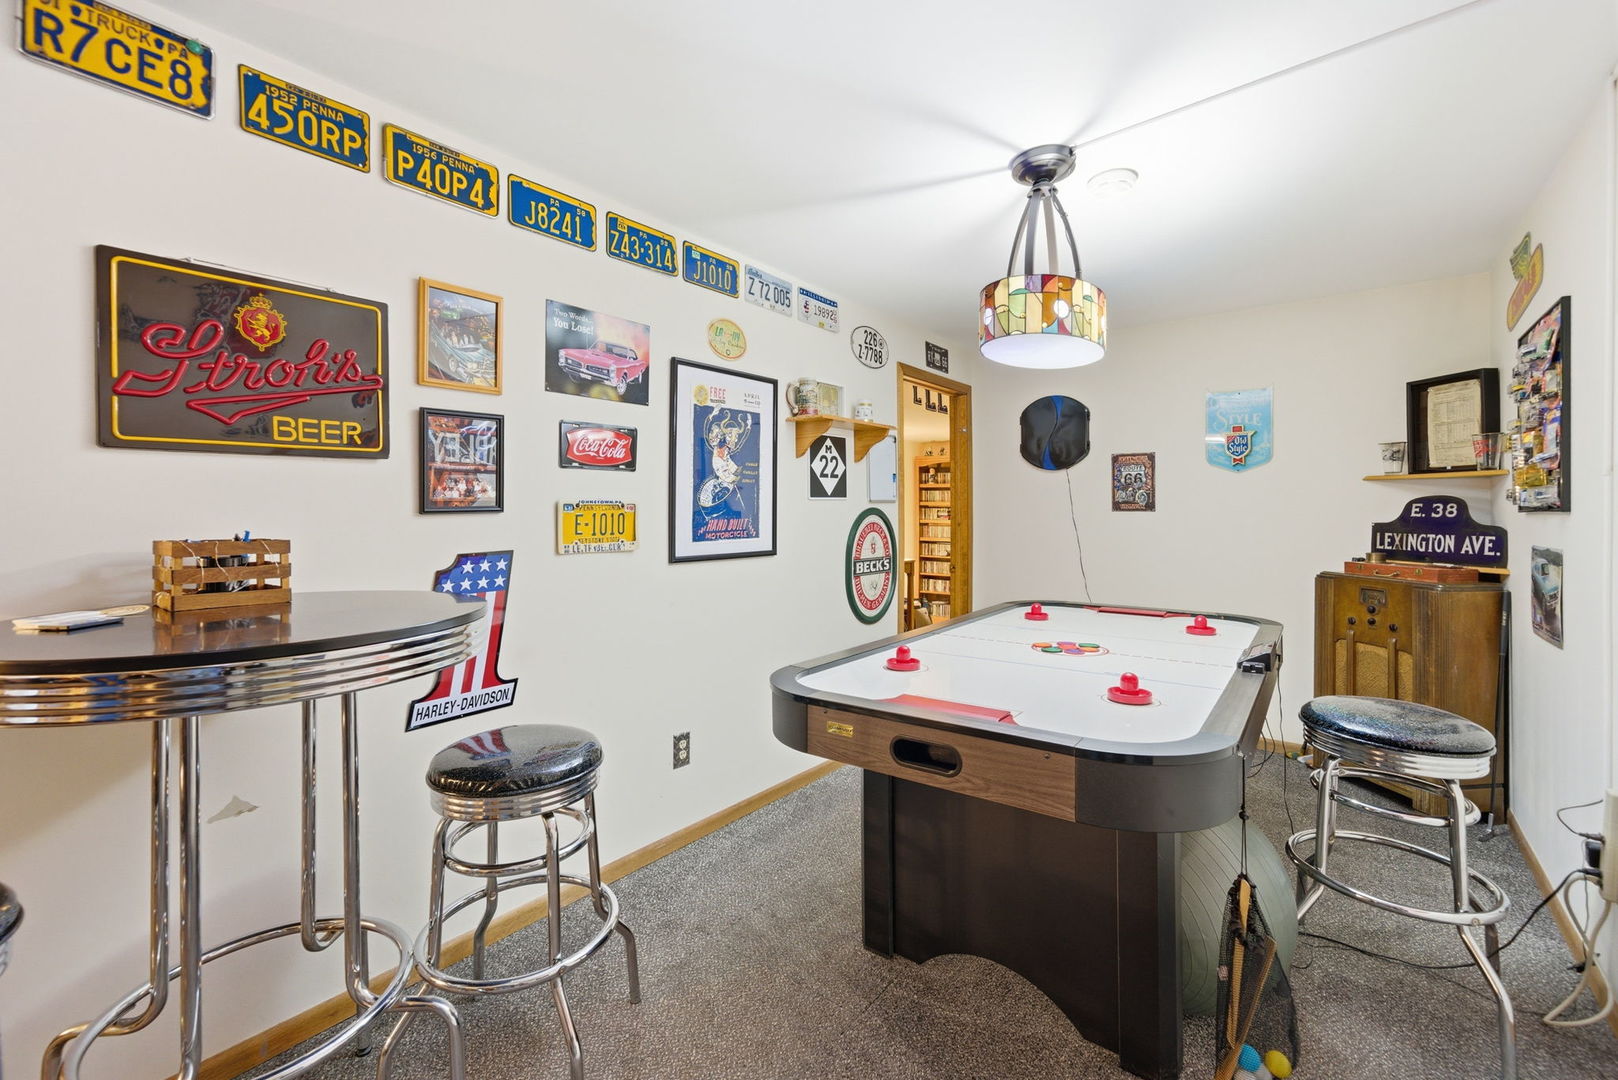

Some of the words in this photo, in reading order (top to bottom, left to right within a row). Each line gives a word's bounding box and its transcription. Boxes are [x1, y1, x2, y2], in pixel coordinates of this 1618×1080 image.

[86, 8, 151, 47] TRUCK
[167, 42, 189, 61] PA
[33, 7, 193, 100] R7CE8
[265, 84, 298, 106] 1952
[302, 98, 345, 123] PENNA
[412, 143, 437, 161] 1956
[442, 154, 476, 174] PENNA
[550, 198, 560, 208] PA
[524, 201, 582, 242] J8241
[639, 231, 648, 240] PA
[693, 260, 732, 290] J1010
[554, 308, 568, 319] Two
[553, 317, 569, 329] You
[571, 321, 594, 336] Lose!
[863, 329, 878, 348] 226
[111, 318, 366, 399] Stroh's
[709, 386, 726, 400] FREE
[272, 415, 362, 445] BEER
[573, 435, 630, 461] Coca-Cola
[825, 445, 832, 454] M
[1228, 443, 1248, 456] Style
[1234, 435, 1247, 445] Old
[819, 455, 839, 479] 22
[1123, 472, 1145, 487] 66
[1410, 503, 1426, 518] E.
[1431, 503, 1458, 518] 38
[575, 513, 625, 537] E-1010
[706, 518, 728, 531] HAND
[728, 518, 748, 531] BUILT
[705, 530, 748, 539] MOTORCYCLE
[1376, 532, 1455, 553] LEXINGTON
[1460, 535, 1501, 556] AVE.
[856, 558, 890, 574] BECK'S
[415, 688, 510, 722] HARLEY-DAVIDSON
